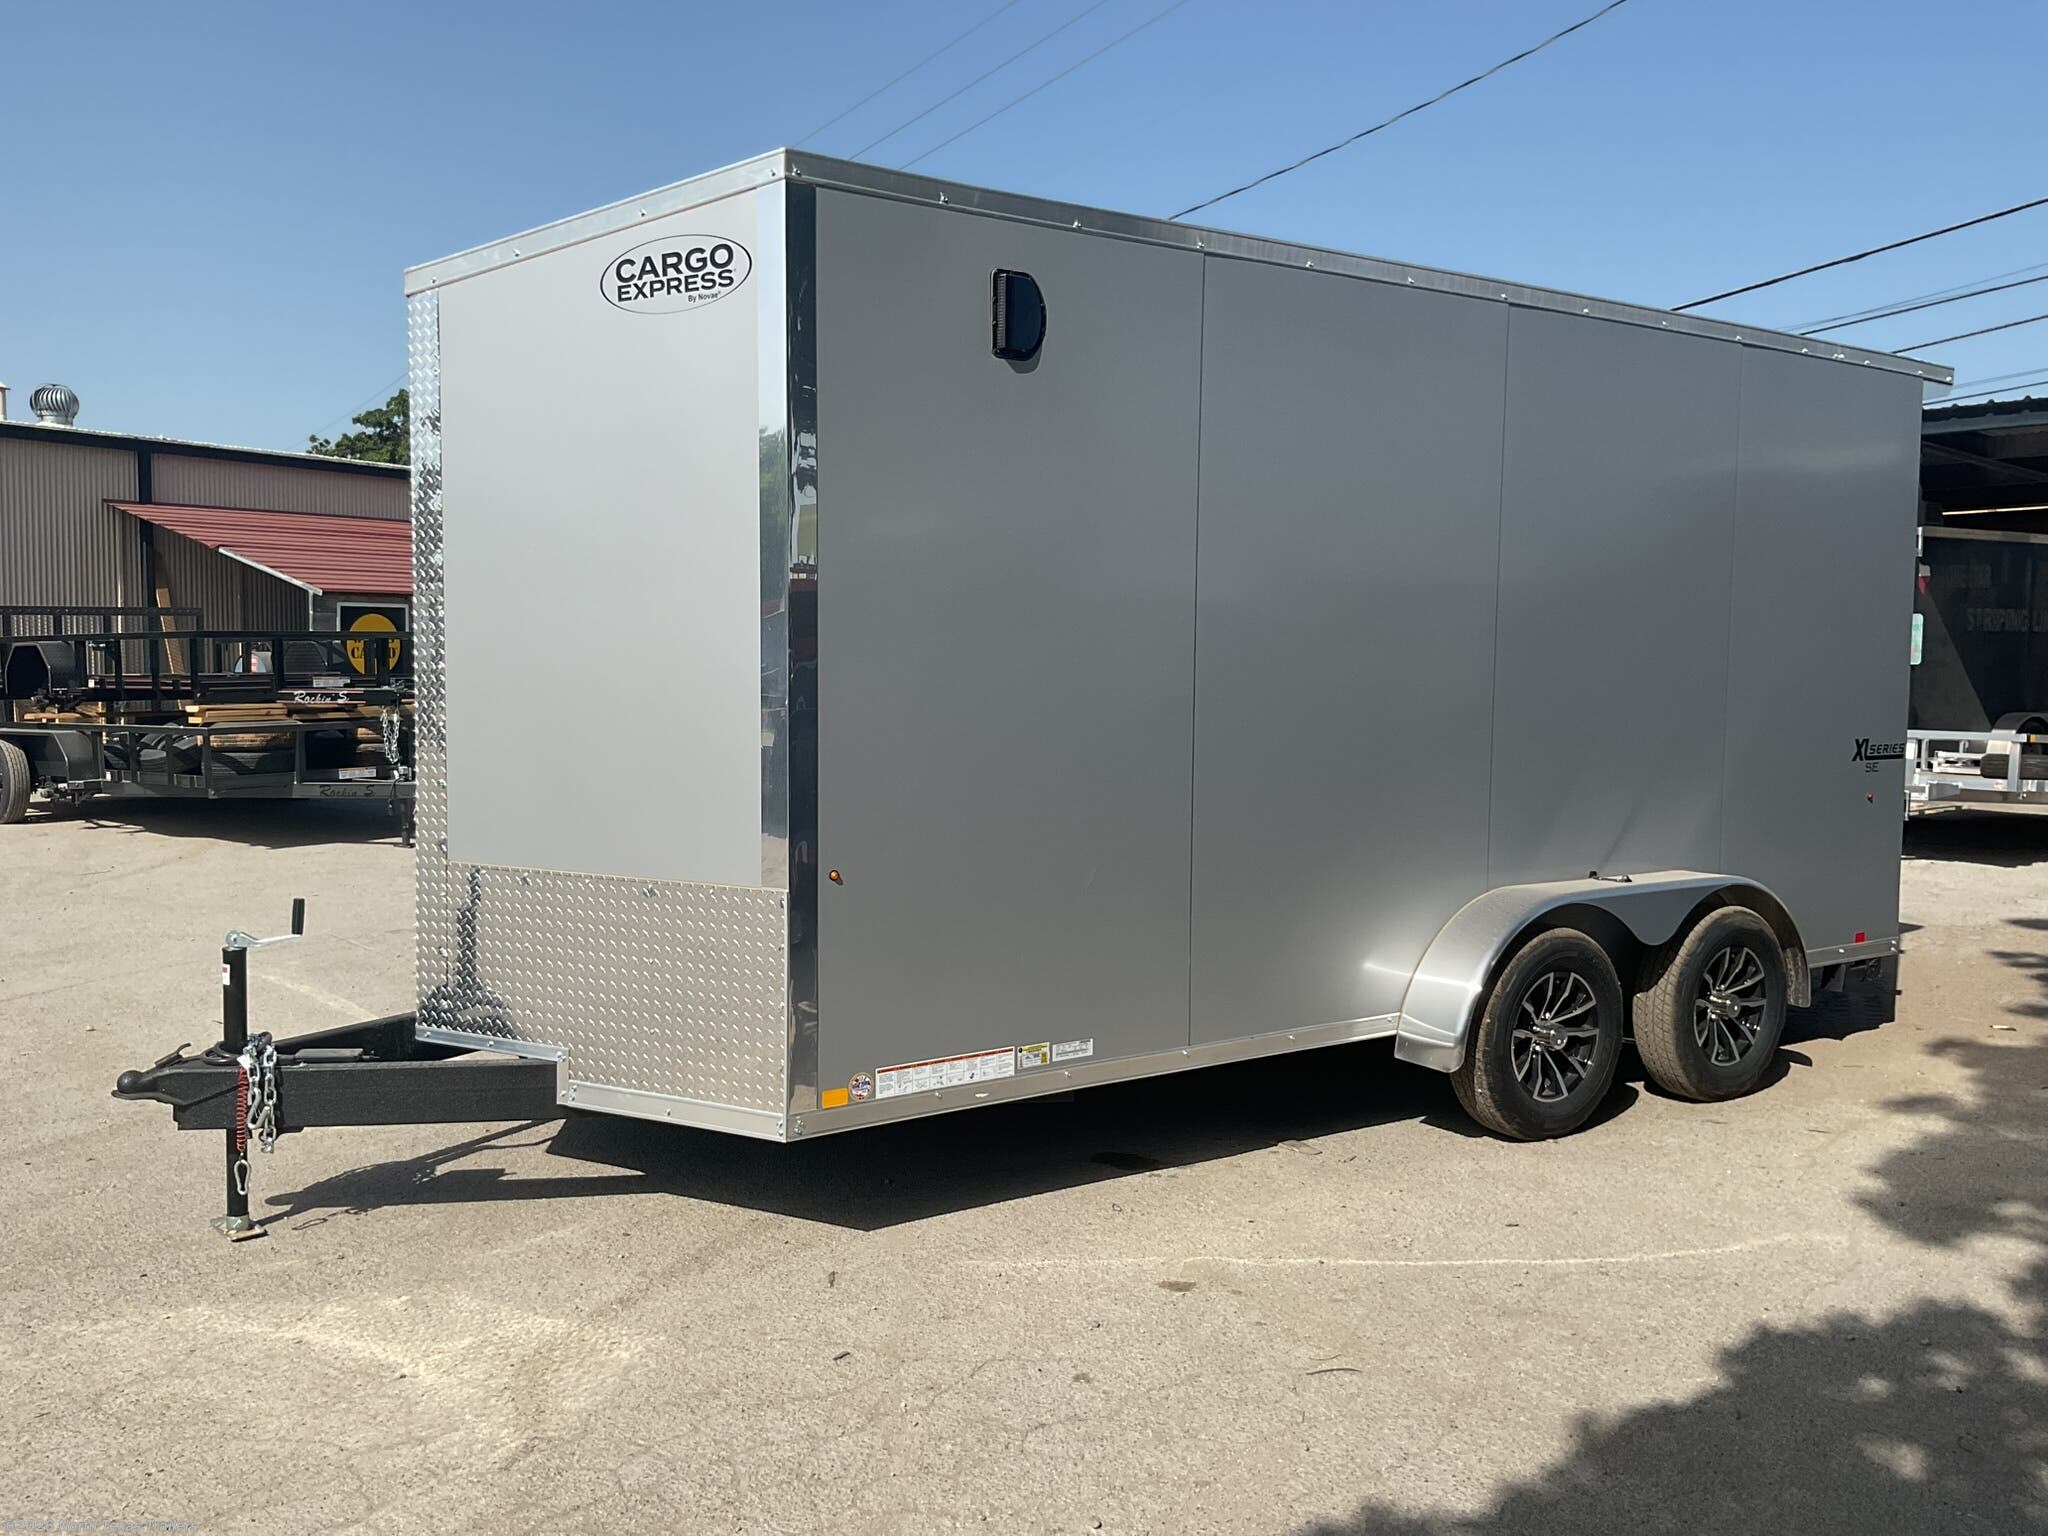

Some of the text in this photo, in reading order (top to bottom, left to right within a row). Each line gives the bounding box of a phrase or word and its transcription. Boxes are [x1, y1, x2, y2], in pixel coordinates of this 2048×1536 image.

[615, 243, 735, 284] CARGO
[617, 269, 735, 303] EXPRESS
[688, 294, 697, 303] By
[1865, 762, 1879, 773] SE
[363, 784, 375, 797] S
